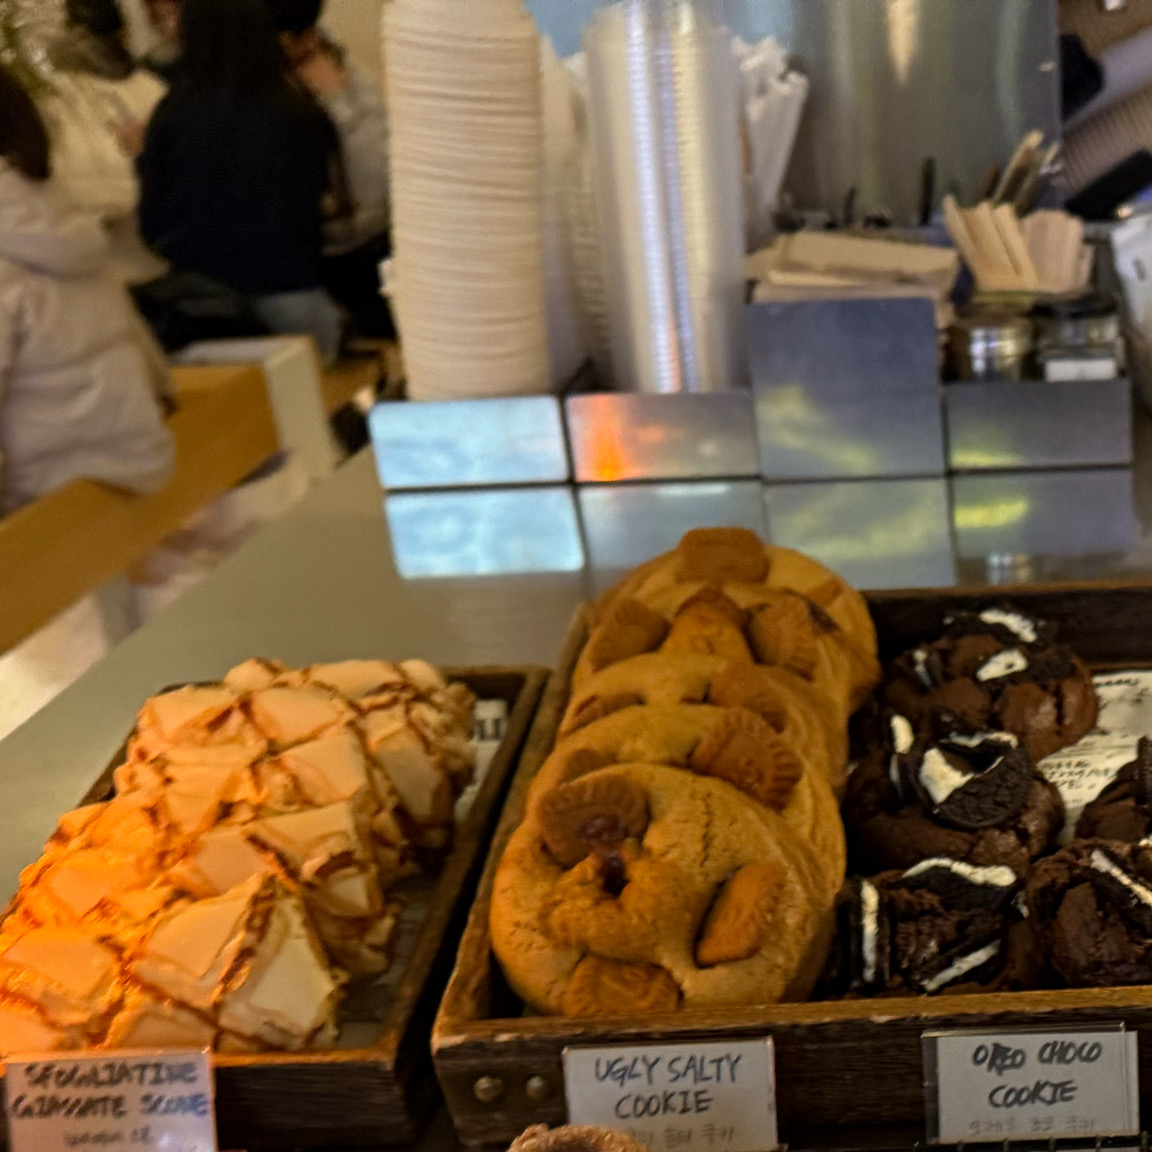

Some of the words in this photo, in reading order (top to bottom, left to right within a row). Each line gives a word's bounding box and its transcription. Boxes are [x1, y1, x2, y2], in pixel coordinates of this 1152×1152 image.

[1038, 1040, 1103, 1065] CHOCO
[595, 1056, 660, 1087] UGLY
[667, 1052, 742, 1083] SALTY
[614, 1090, 713, 1120] COOKIE
[988, 1079, 1078, 1109] COOKIE
